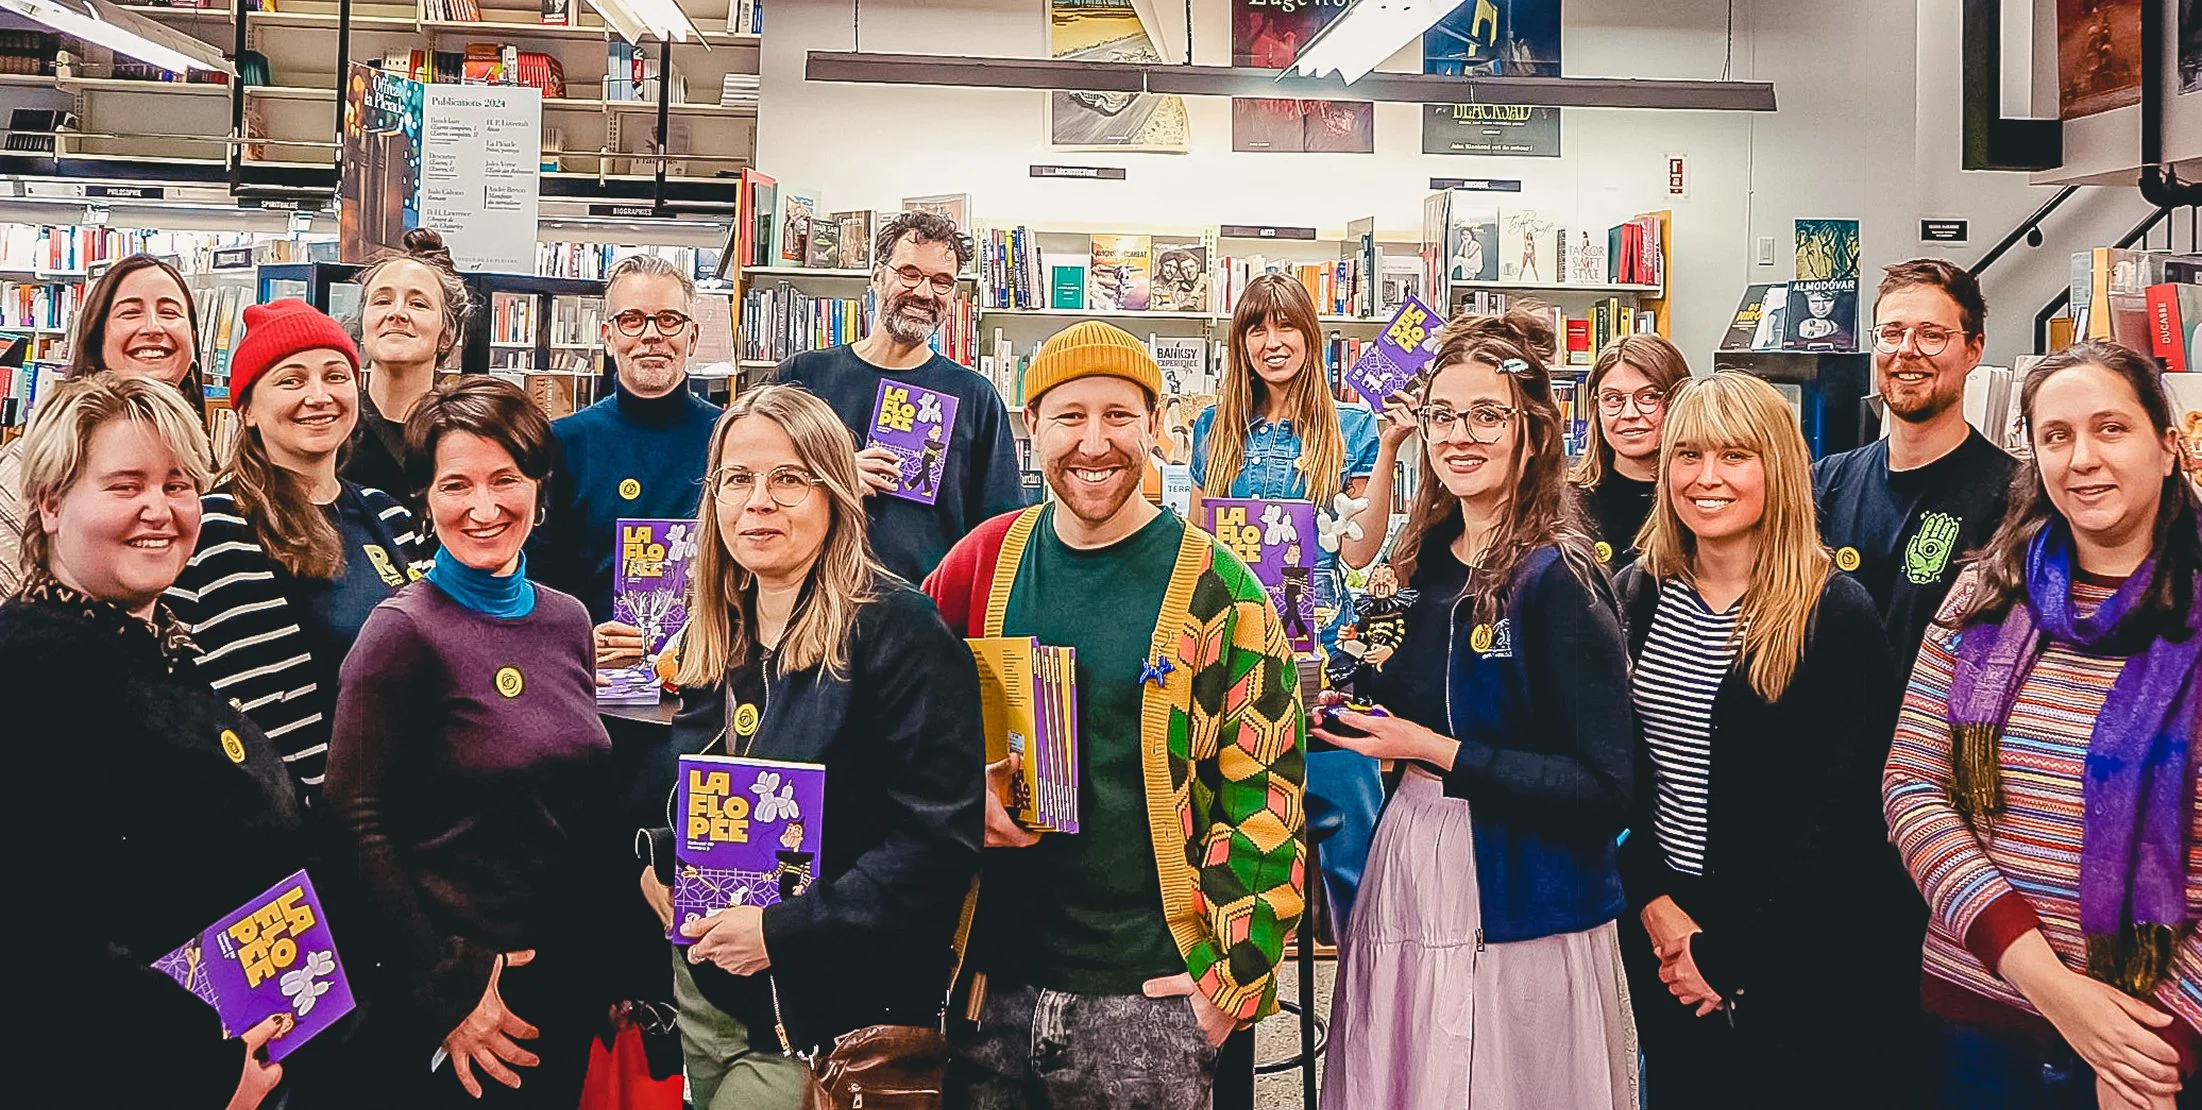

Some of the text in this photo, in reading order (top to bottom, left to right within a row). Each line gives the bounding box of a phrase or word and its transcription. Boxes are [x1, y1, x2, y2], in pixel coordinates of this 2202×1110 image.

[432, 97, 506, 107] Publications 2024
[612, 207, 653, 216] BIOGRAPHIES
[1568, 246, 1605, 257] TAYLOR
[1572, 269, 1600, 280] STYLE
[1792, 279, 1856, 292] ALMODÓVAR
[1406, 302, 1428, 326] LA
[1737, 310, 1764, 321] NIRO
[1747, 303, 1760, 311] DE
[1157, 347, 1198, 359] BANKSY
[884, 385, 910, 404] LA
[880, 398, 916, 419] FLO
[1215, 506, 1247, 526] LA
[624, 526, 652, 544] LA
[1215, 525, 1261, 546] FLO
[624, 544, 665, 561] FLO
[690, 770, 731, 797] LA
[689, 794, 750, 820] FLO
[687, 813, 750, 843] PÉE
[276, 886, 316, 937] LA
[252, 900, 297, 968] FLO
